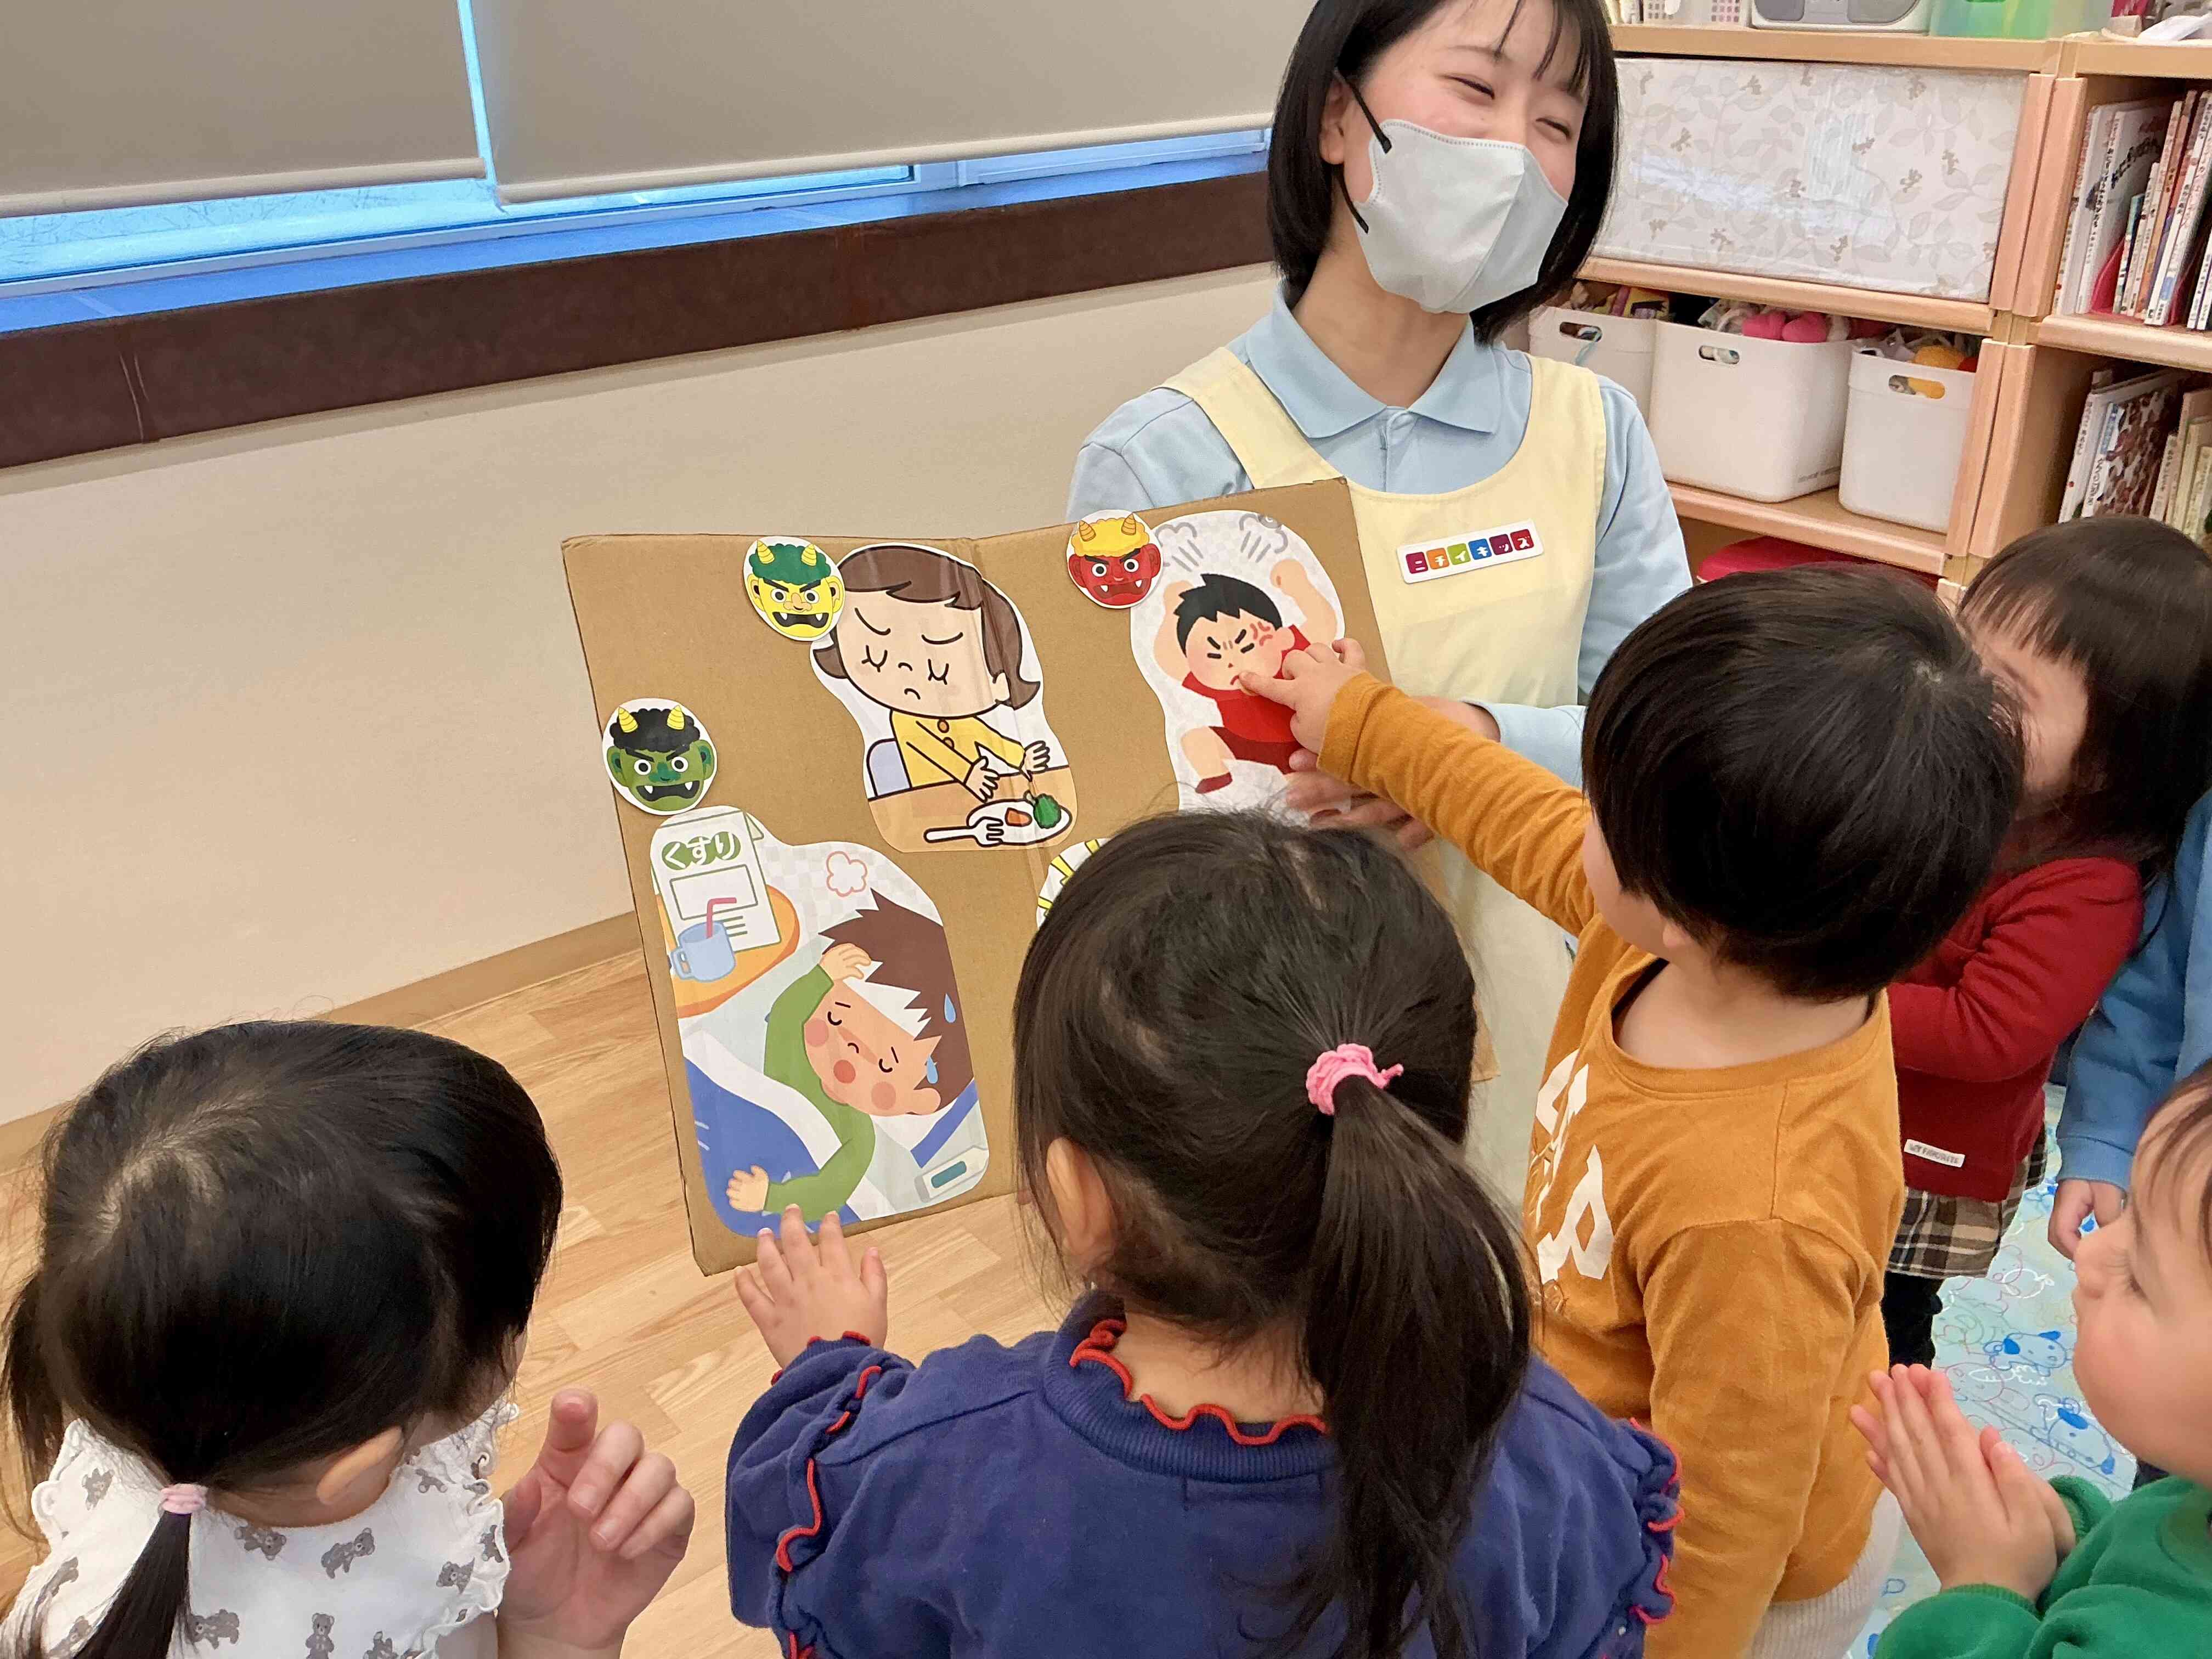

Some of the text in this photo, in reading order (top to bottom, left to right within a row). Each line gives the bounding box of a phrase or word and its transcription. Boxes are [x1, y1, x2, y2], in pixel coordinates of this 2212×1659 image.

[1413, 533, 1532, 572] ニチイキッズ
[664, 831, 737, 869] くすり
